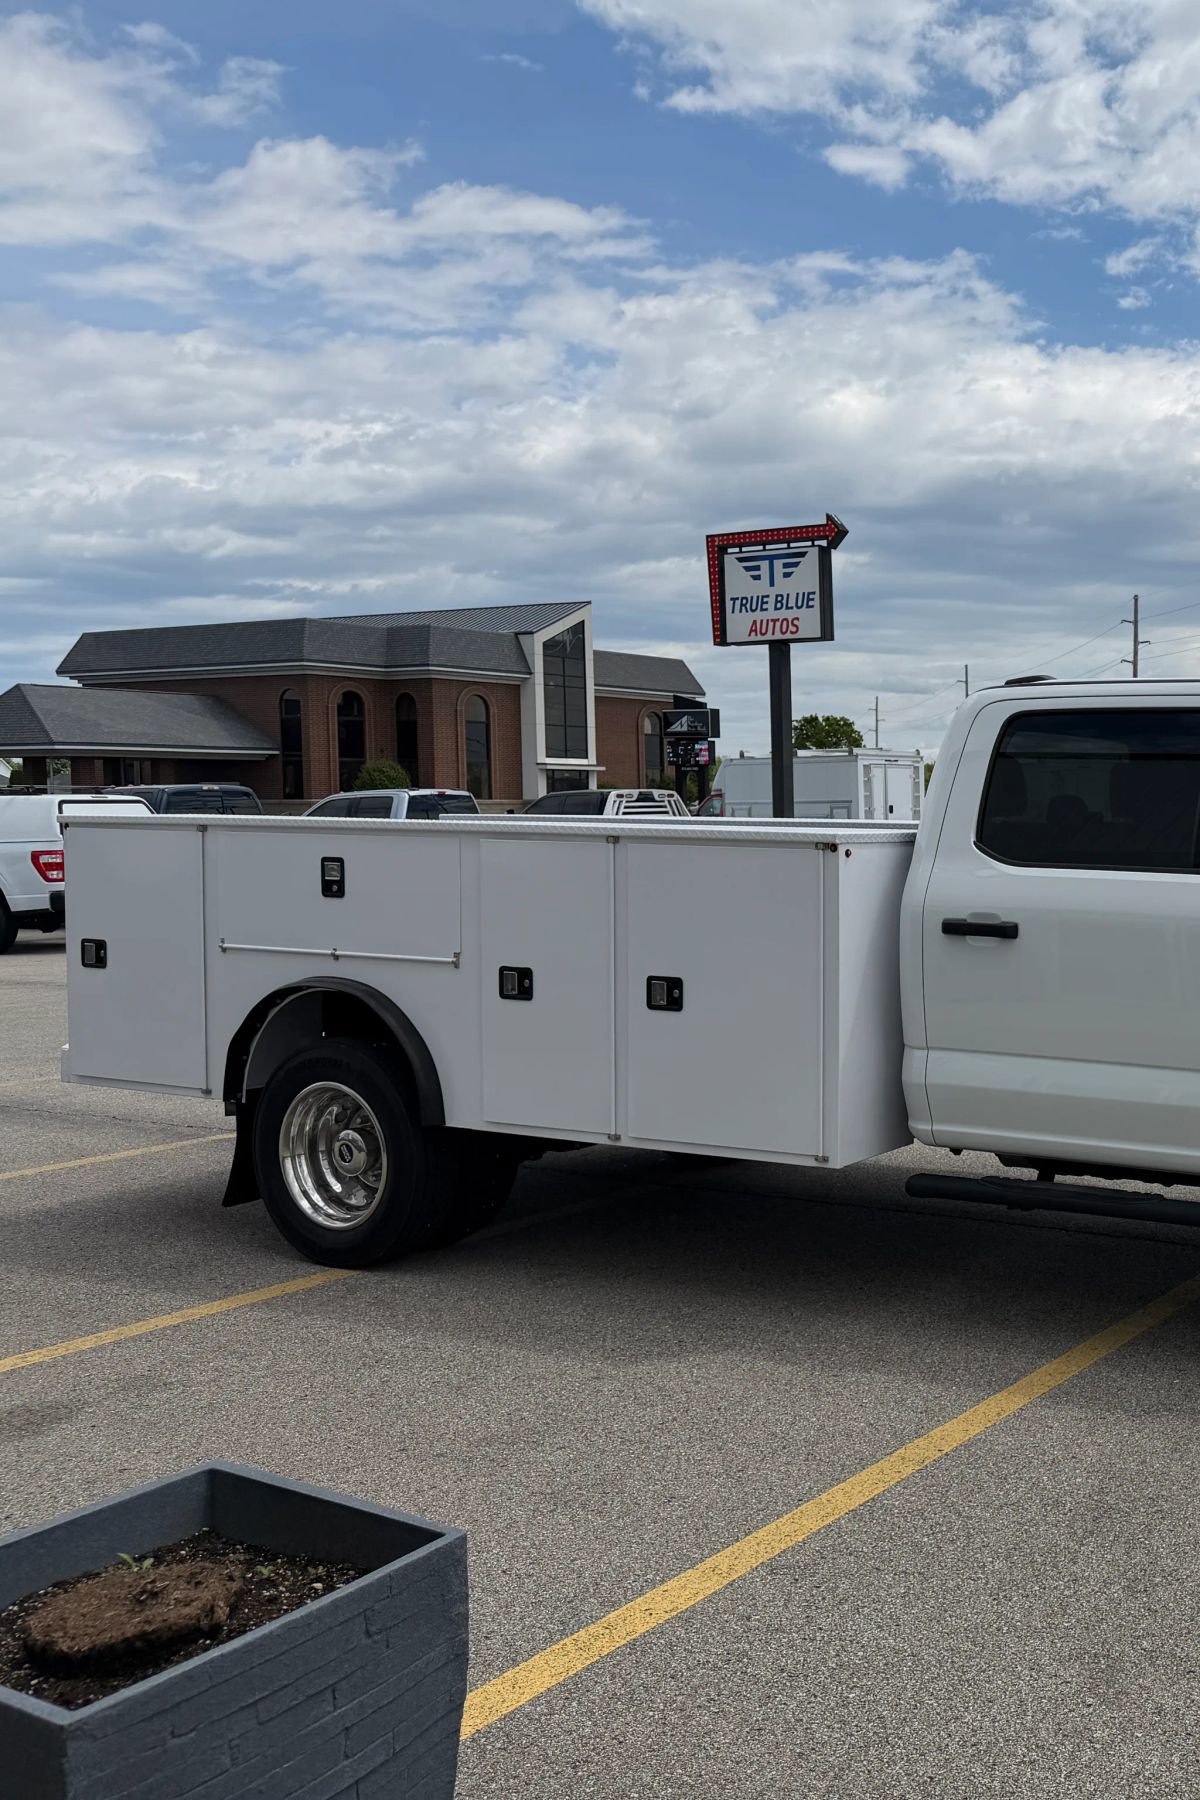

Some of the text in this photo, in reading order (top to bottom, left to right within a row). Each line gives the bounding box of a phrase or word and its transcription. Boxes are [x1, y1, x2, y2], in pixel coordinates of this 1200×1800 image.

[730, 591, 816, 614] TRUE BLUE
[748, 617, 800, 637] AUTOS
